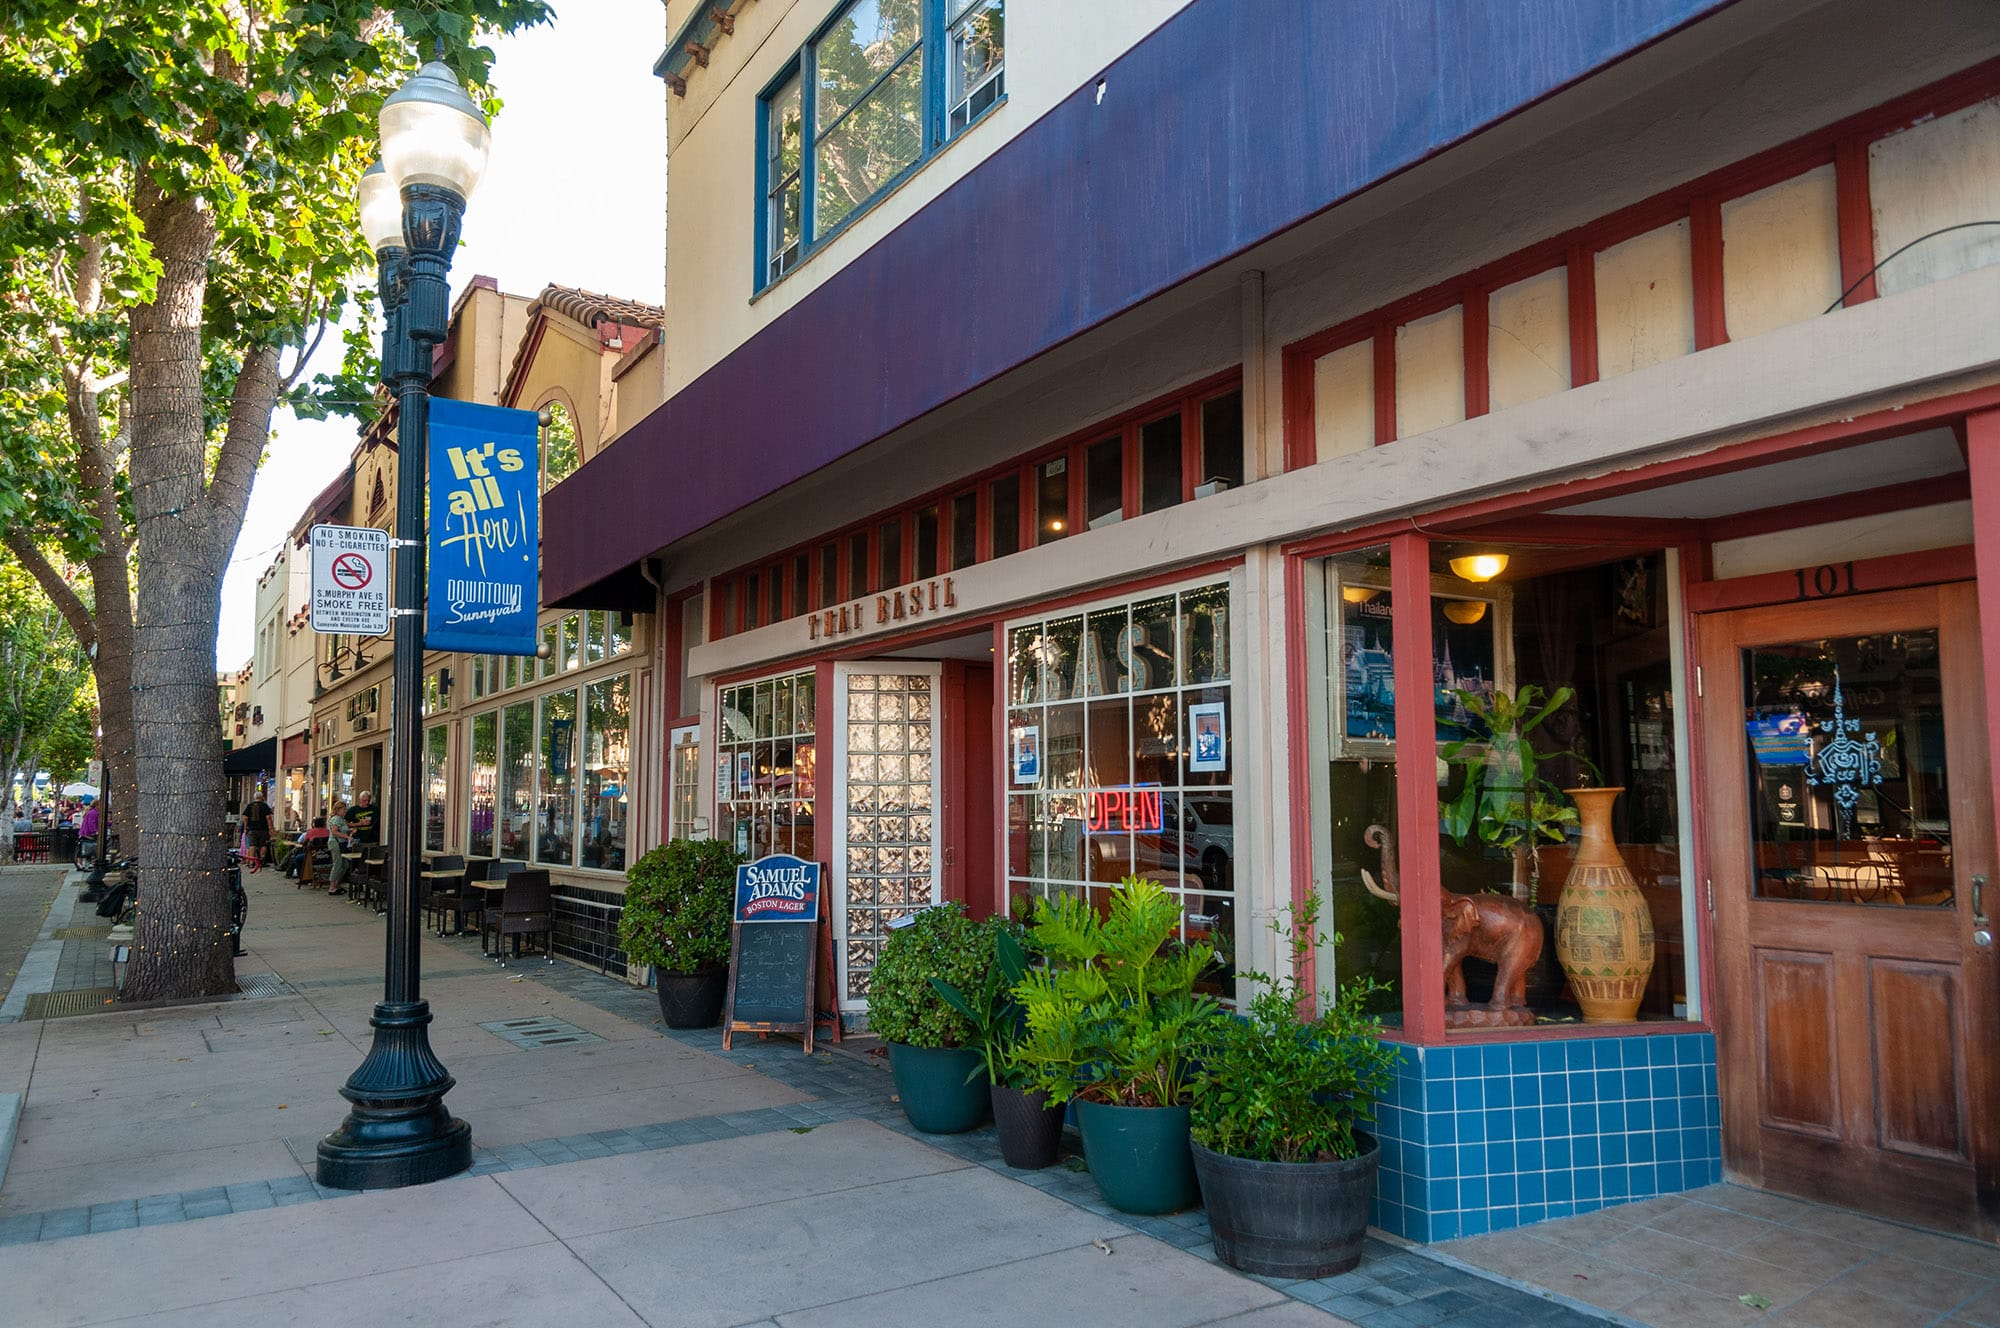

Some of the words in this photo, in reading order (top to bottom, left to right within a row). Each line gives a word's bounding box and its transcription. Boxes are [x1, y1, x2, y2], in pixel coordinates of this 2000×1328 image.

[446, 442, 525, 480] It's
[447, 476, 505, 516] all
[321, 530, 332, 538] NO
[339, 531, 380, 542] SMOKING
[440, 489, 529, 578] Here!
[329, 541, 385, 552] E-CIGARETTES
[447, 579, 522, 605] DOWNTOWN
[1795, 561, 1857, 600] 101
[317, 600, 353, 609] SMOKE
[358, 602, 385, 611] FREE
[359, 592, 372, 600] AVE
[446, 600, 522, 624] Sunnyvale
[808, 603, 863, 640] THAI
[876, 577, 956, 624] BASIL
[1087, 788, 1161, 832] OPEN
[746, 865, 811, 886] SAMUEL
[748, 882, 805, 903] ADAMS
[746, 900, 778, 914] BOSTON
[779, 901, 805, 911] LAGER
